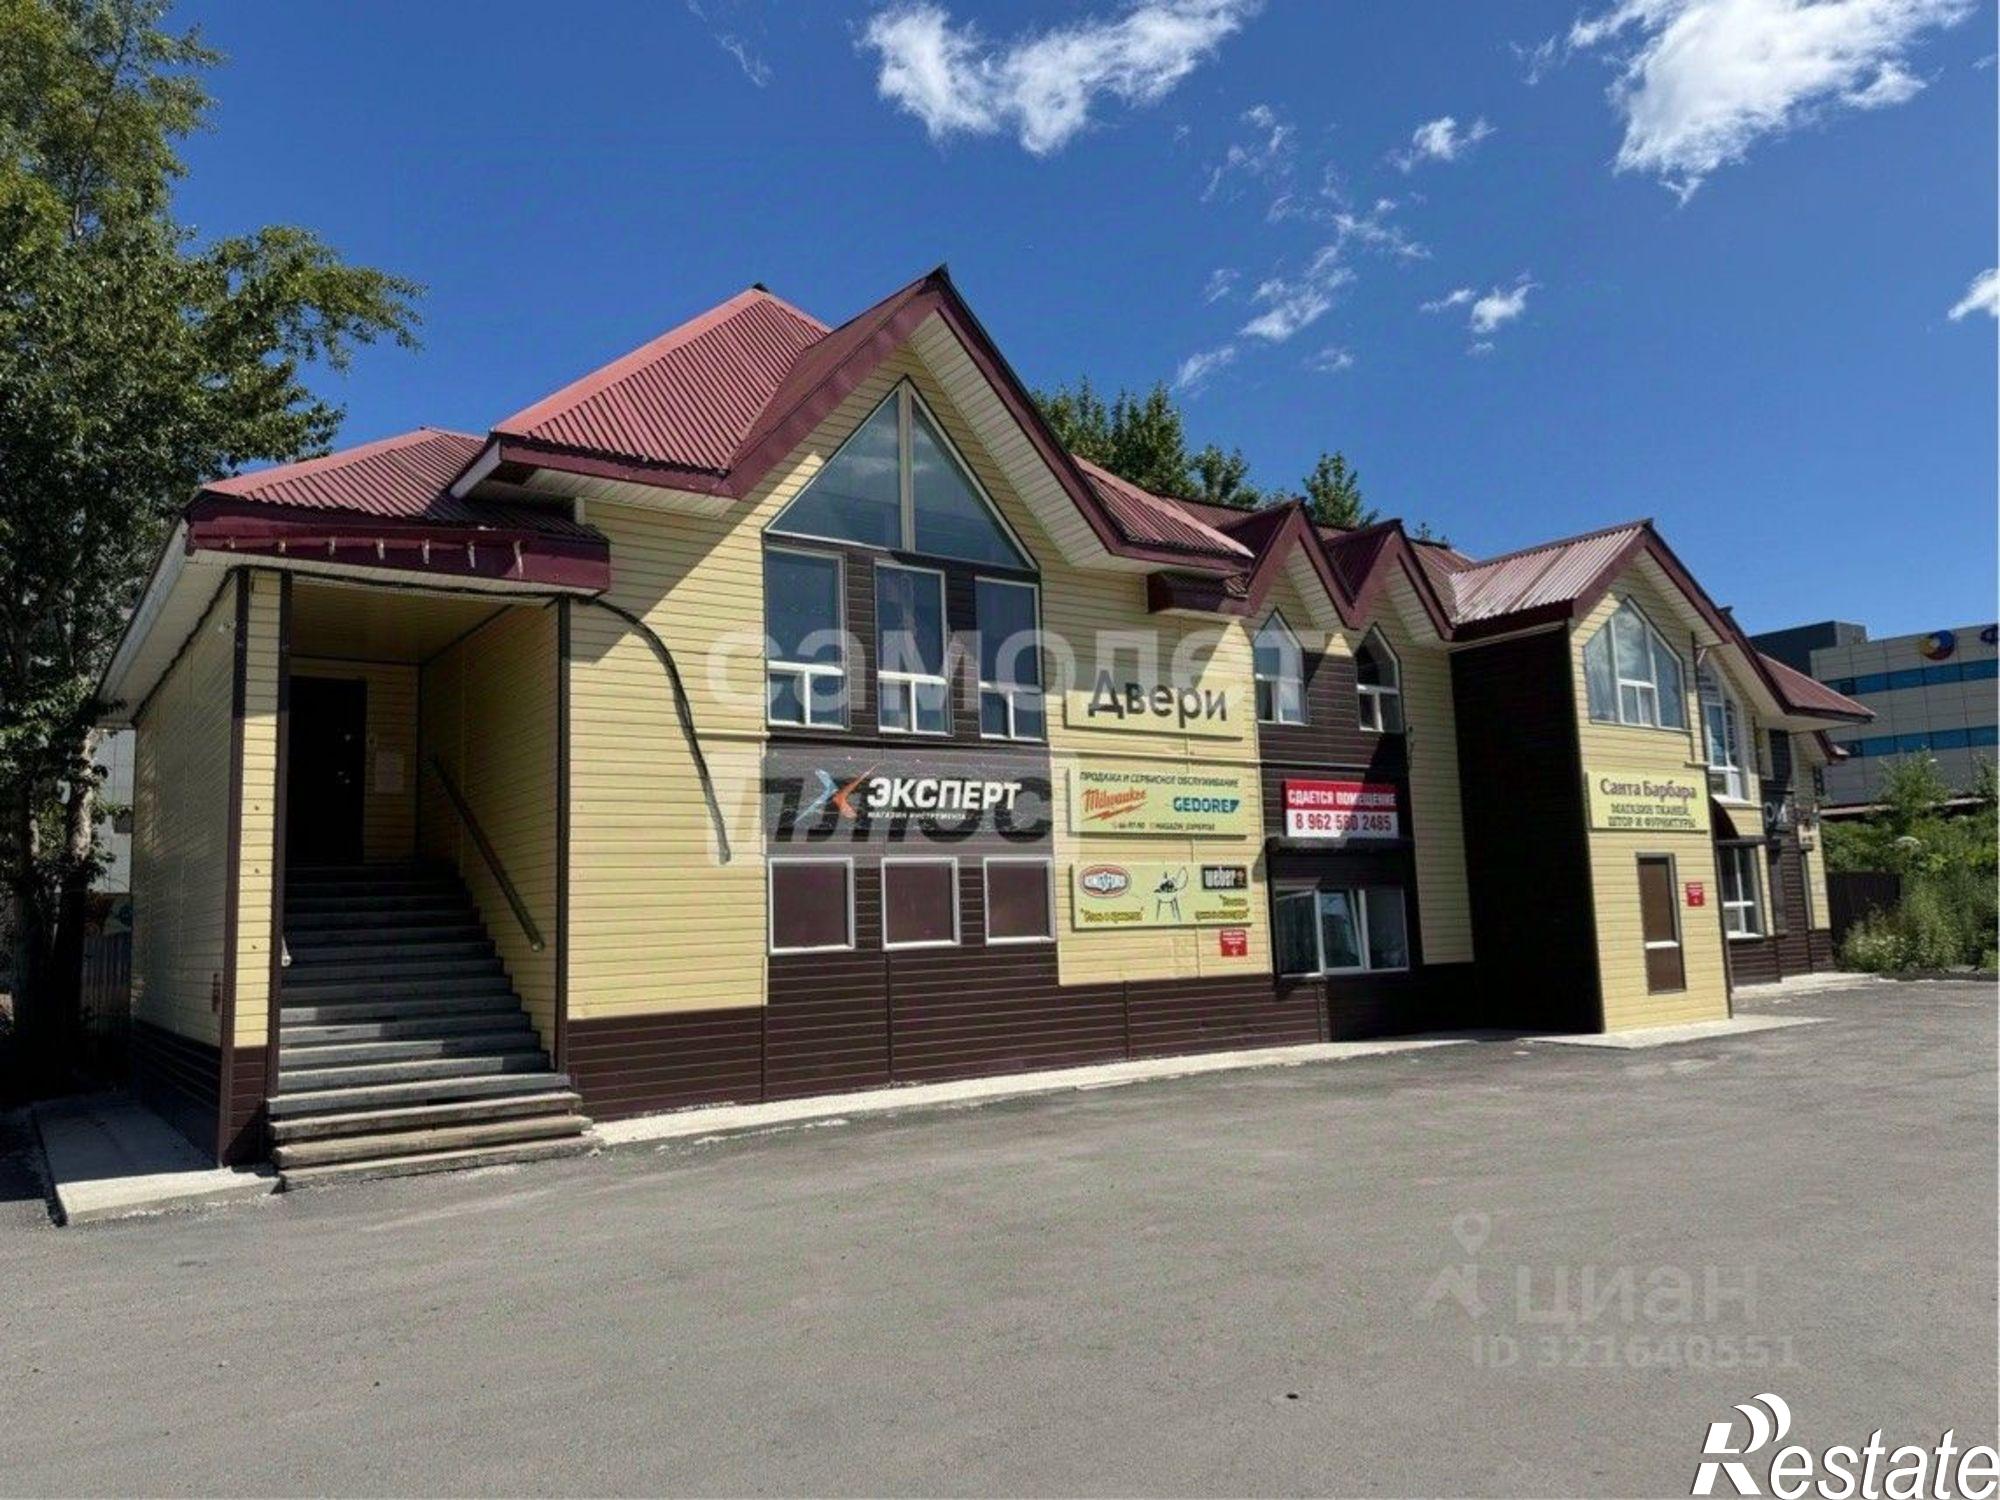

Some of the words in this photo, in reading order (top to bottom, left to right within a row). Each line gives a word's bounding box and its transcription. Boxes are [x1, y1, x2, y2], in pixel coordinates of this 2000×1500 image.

[1087, 669, 1228, 728] Двери
[1080, 772, 1121, 782] ПРОДАЖА
[1122, 775, 1128, 783] И
[1130, 775, 1176, 785] СЕРВИСНОЕ
[1177, 776, 1239, 788] ОБСЛУЖИВАНИЕ
[867, 777, 1022, 810] ЭКСПЕРТ
[1288, 789, 1334, 805] СДАЕТСЯ
[1336, 791, 1397, 806] ПОМЕЩЕНИЕ
[1600, 778, 1641, 796] Санта
[1643, 780, 1697, 803] Барбара
[1173, 797, 1232, 813] GEDORE
[1611, 803, 1654, 814] МАГАЗИН
[1295, 813, 1304, 830] 8
[1308, 813, 1332, 830] 962
[1362, 814, 1392, 831] 2485
